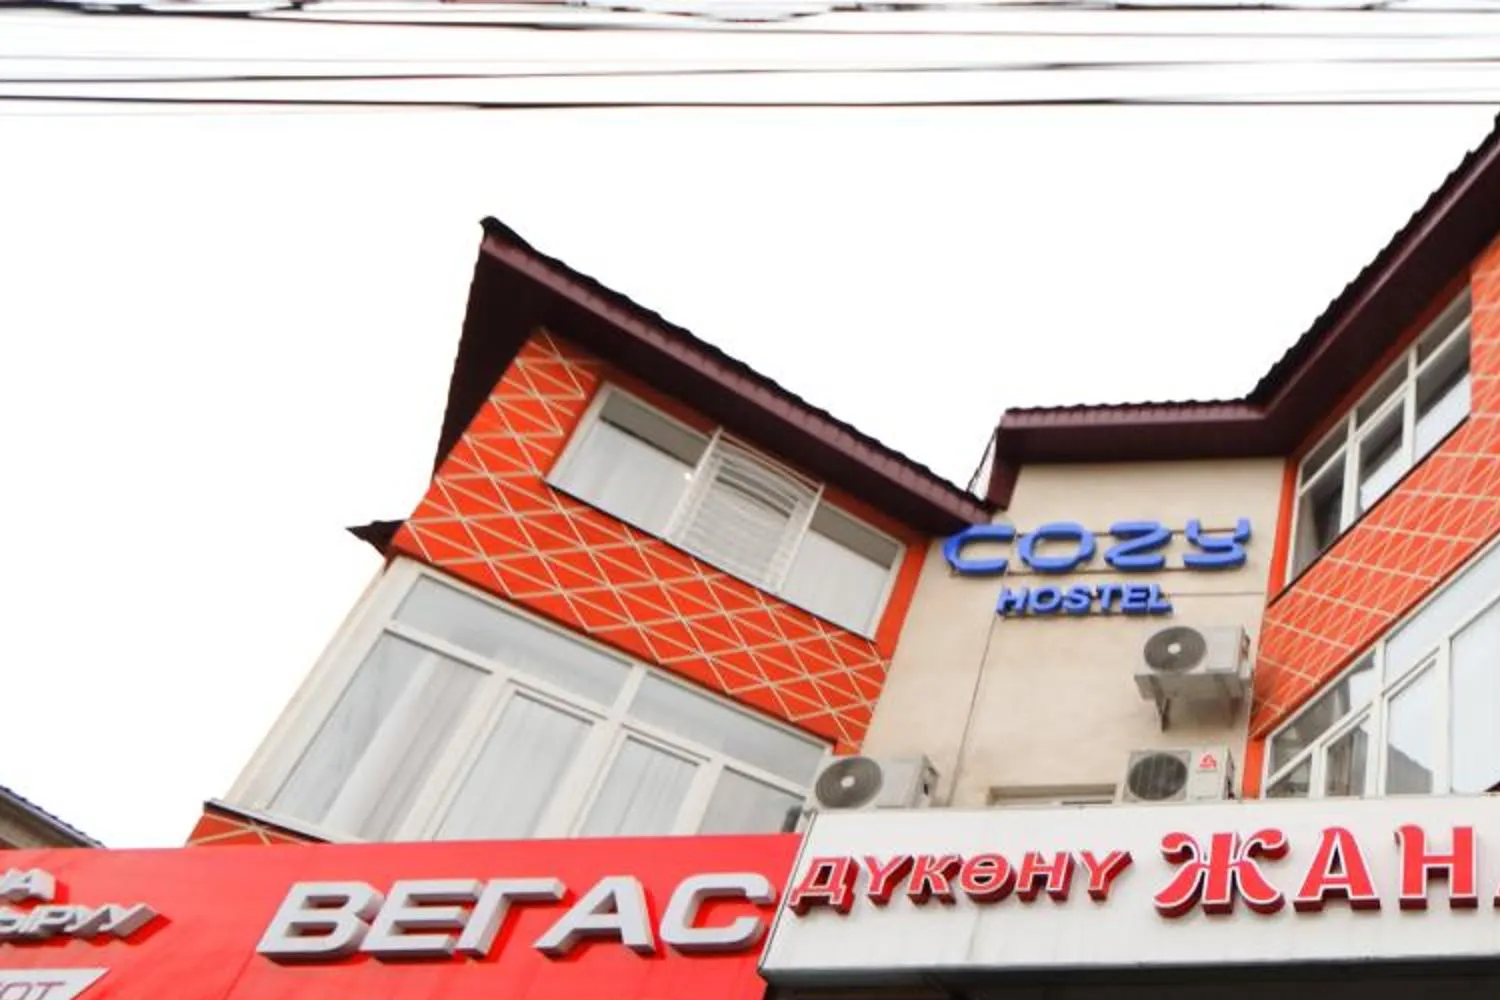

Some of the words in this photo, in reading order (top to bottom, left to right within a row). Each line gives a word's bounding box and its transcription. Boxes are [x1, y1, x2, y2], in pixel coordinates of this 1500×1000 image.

[942, 517, 1255, 577] COZY
[996, 583, 1174, 617] HOSTEL
[256, 872, 775, 957] ВЕГАС
